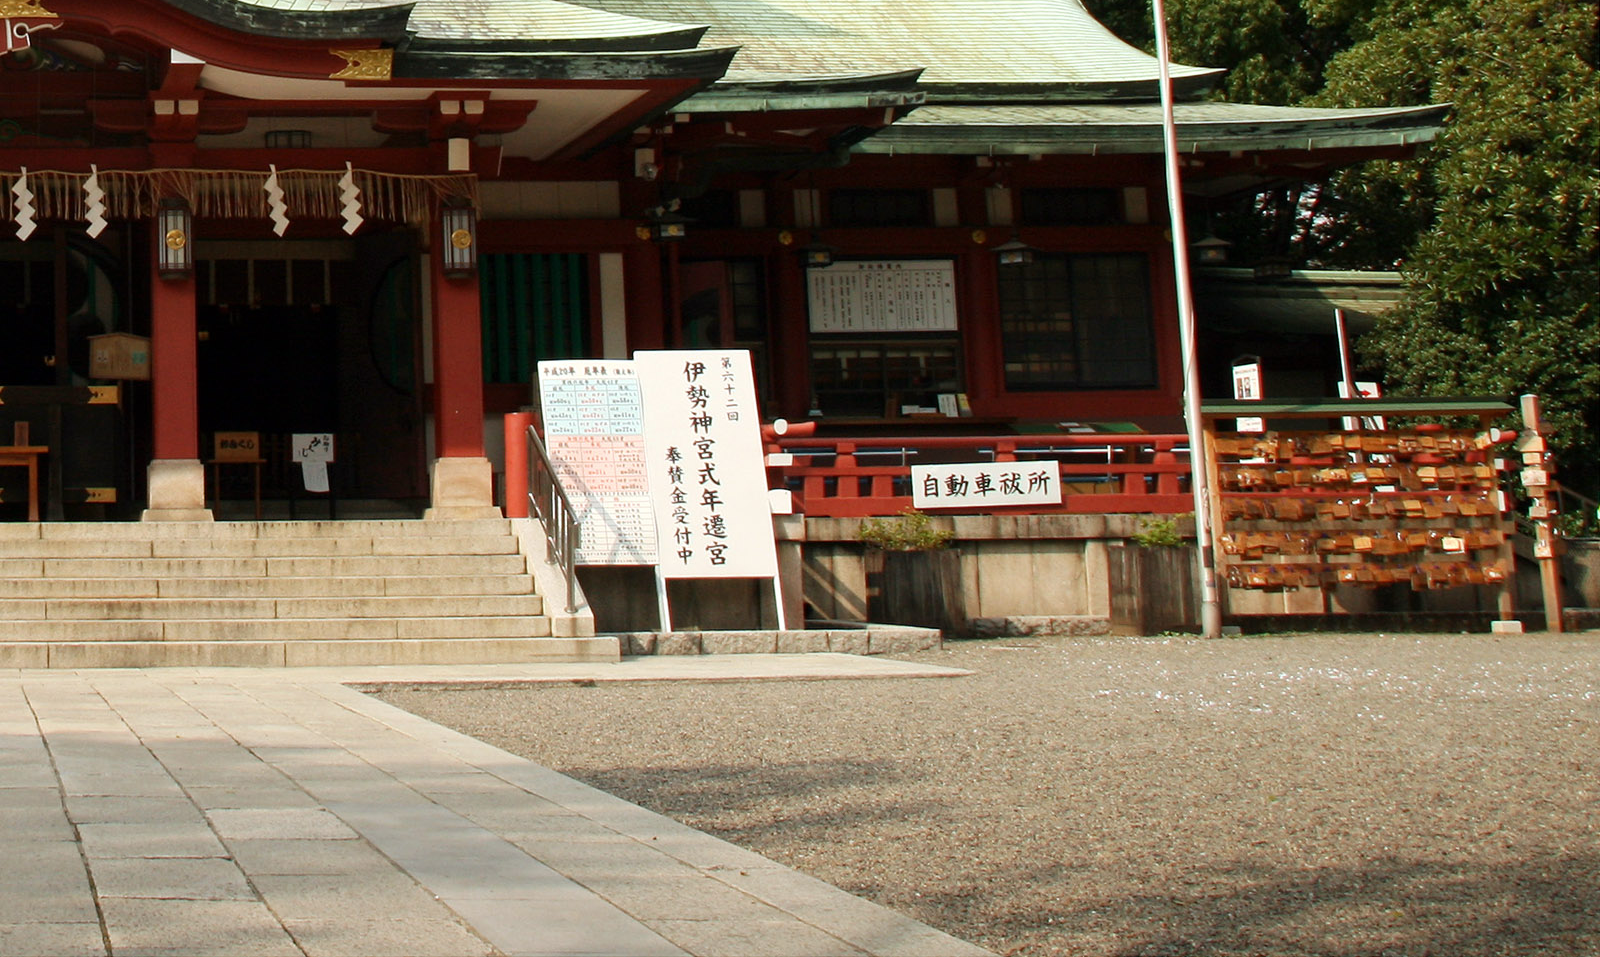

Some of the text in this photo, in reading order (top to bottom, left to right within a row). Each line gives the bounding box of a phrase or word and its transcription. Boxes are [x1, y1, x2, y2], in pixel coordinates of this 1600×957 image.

[543, 365, 576, 377] 平成20年
[720, 356, 739, 422] 第六十二回
[682, 360, 729, 566] 伊勢神宮式年遷宮
[922, 469, 1051, 498] 自動車祓所
[665, 445, 694, 566] 奉賛金受付中
